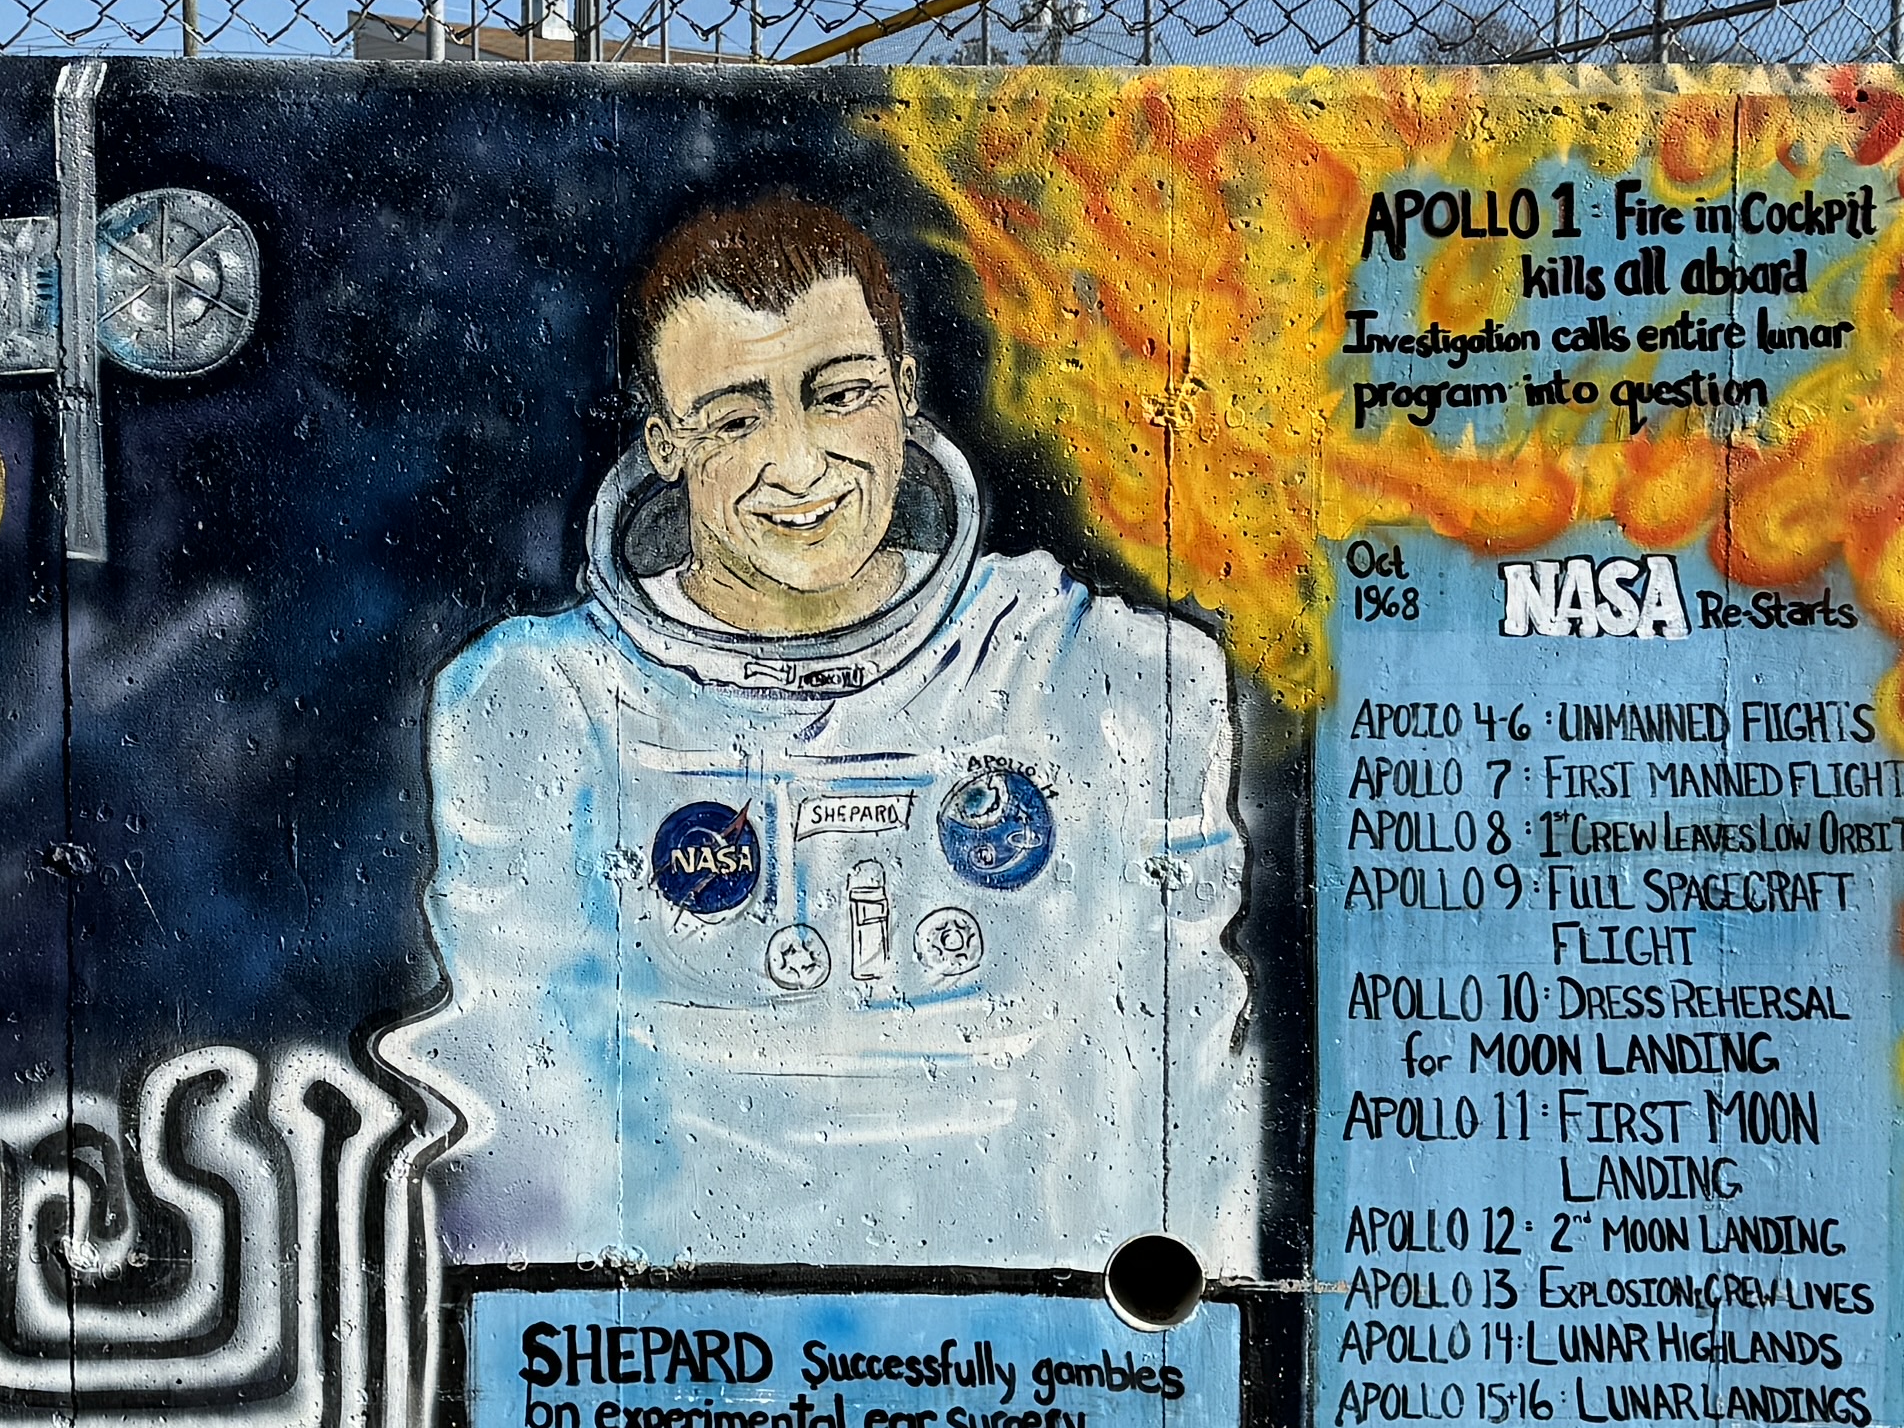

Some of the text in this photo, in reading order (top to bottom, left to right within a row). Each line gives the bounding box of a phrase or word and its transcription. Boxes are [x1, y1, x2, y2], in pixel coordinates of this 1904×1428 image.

[1361, 188, 1540, 260] APOLLO
[1615, 180, 1685, 241] Fire
[1695, 200, 1732, 234] in
[1522, 246, 1807, 300] kills all aboard
[1343, 307, 1854, 368] Investigation calls entire lunar
[1354, 371, 1767, 434] program into question
[1347, 540, 1858, 639] Oct NASA Re-Starts
[1354, 586, 1419, 621] 1968
[1348, 756, 1462, 799] APOLLO
[1544, 755, 1635, 799] FIRST
[1647, 761, 1783, 798] MANNED
[811, 804, 898, 824] SHEPARD
[1348, 811, 1476, 852] APOLLO
[1571, 813, 1657, 854] CREW
[1664, 811, 1758, 852] LEAVES
[1760, 814, 1811, 852] LOW
[671, 845, 753, 874] NASA
[1344, 866, 1484, 912] APOLLO
[1643, 868, 1854, 913] SPACECRAFT
[1552, 921, 1696, 966] FLIGHT
[1348, 972, 1482, 1022] APOLLO
[1558, 978, 1664, 1020] DRESS
[1672, 978, 1850, 1022] REHERSAL
[1401, 1031, 1780, 1078] for MOON LANDING
[1342, 1090, 1478, 1141] APOLLO
[1558, 1088, 1691, 1144] FIRST
[1704, 1089, 1820, 1145] MOON
[1561, 1156, 1743, 1203] LANDING
[1345, 1206, 1468, 1253] APOLLO
[1550, 1211, 1592, 1252] 2nd
[1602, 1215, 1688, 1254] MOON
[1699, 1215, 1846, 1257] LANDING
[1348, 1269, 1472, 1309] APOLLO
[1485, 1274, 1517, 1308] 13
[1704, 1273, 1779, 1308] CREW
[1786, 1277, 1875, 1315] LIVES
[519, 1321, 1185, 1405] SHEPARD Successfully gambles
[1338, 1320, 1471, 1364] APOLLO
[1527, 1321, 1650, 1365] LUNAR
[1657, 1321, 1843, 1369] HIGHLANDS
[1335, 1380, 1464, 1427] APOLLO
[1576, 1378, 1698, 1423] LUNAR
[1701, 1383, 1872, 1427] LANDINGS
